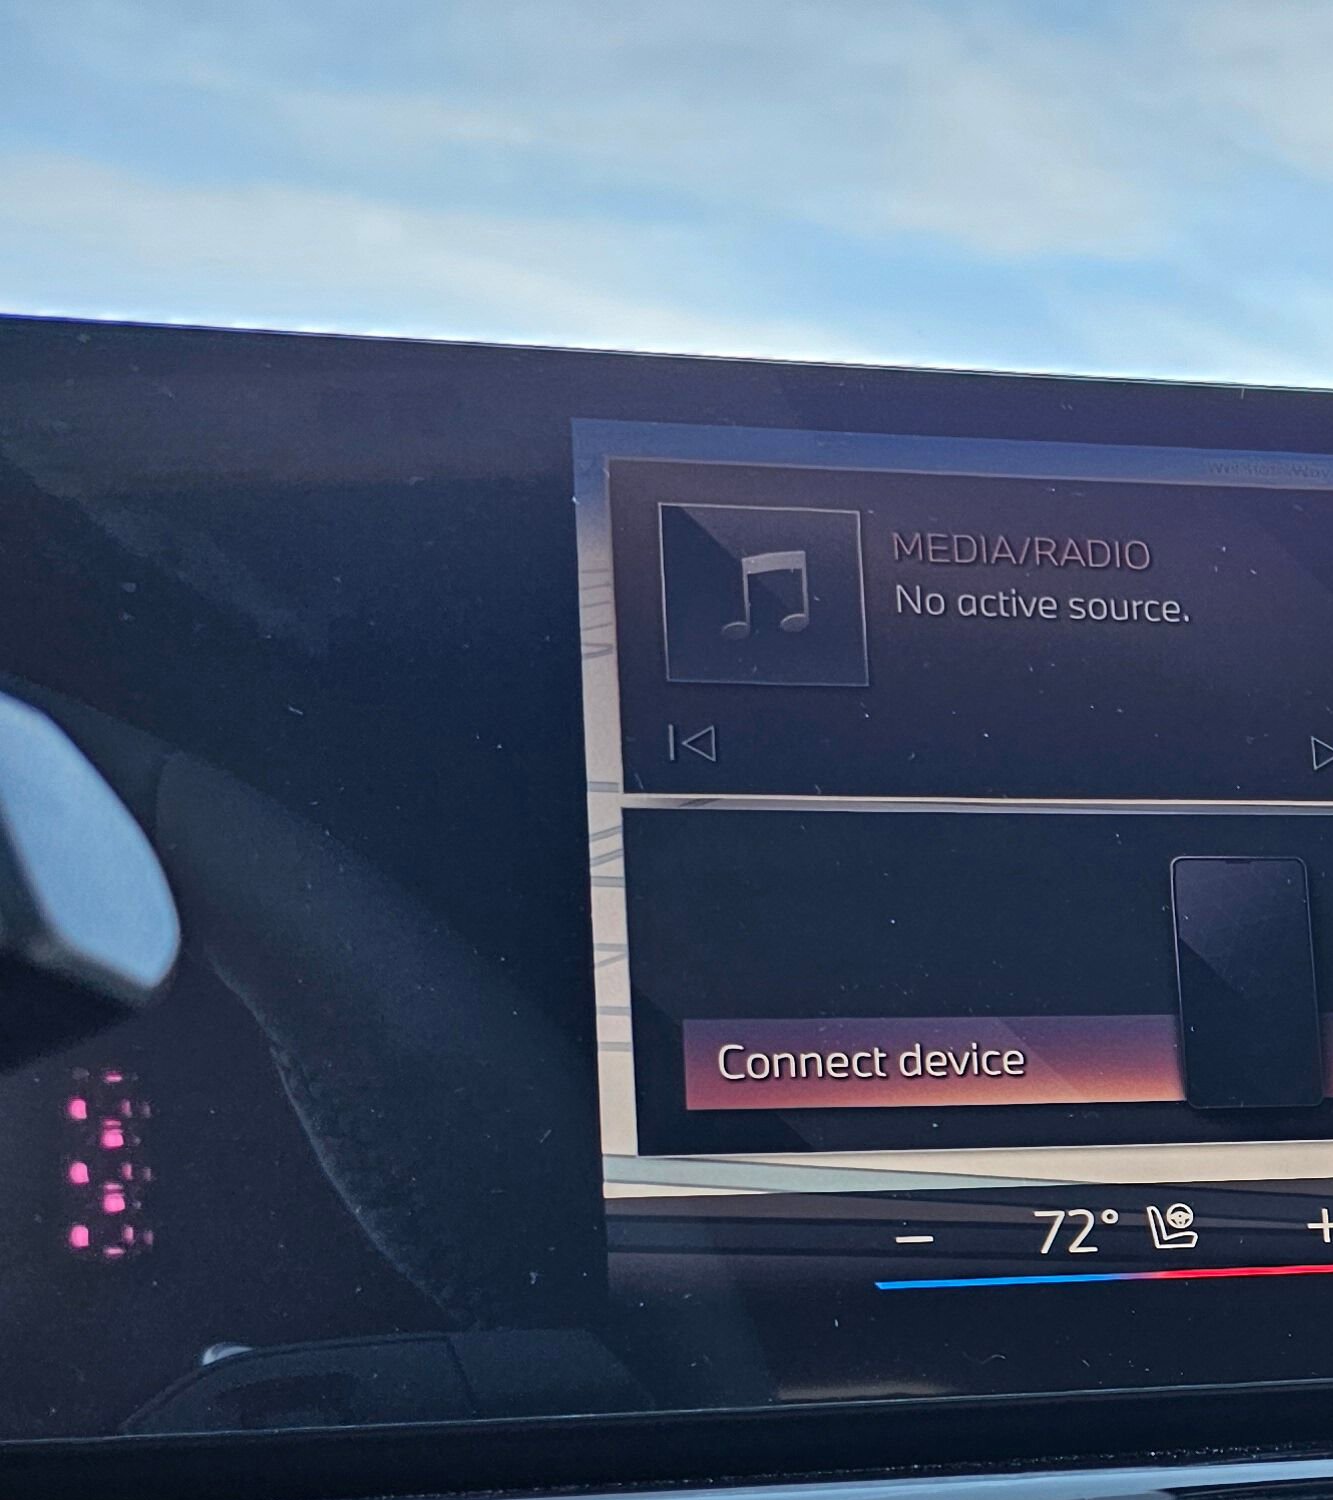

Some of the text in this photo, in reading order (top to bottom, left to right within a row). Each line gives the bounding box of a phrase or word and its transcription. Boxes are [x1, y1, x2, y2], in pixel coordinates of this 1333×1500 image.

[892, 532, 1151, 571] MEDIA/RADIO
[896, 584, 1191, 624] No active source.
[717, 1042, 1025, 1080] Connect device
[1033, 1207, 1119, 1254] 72°
